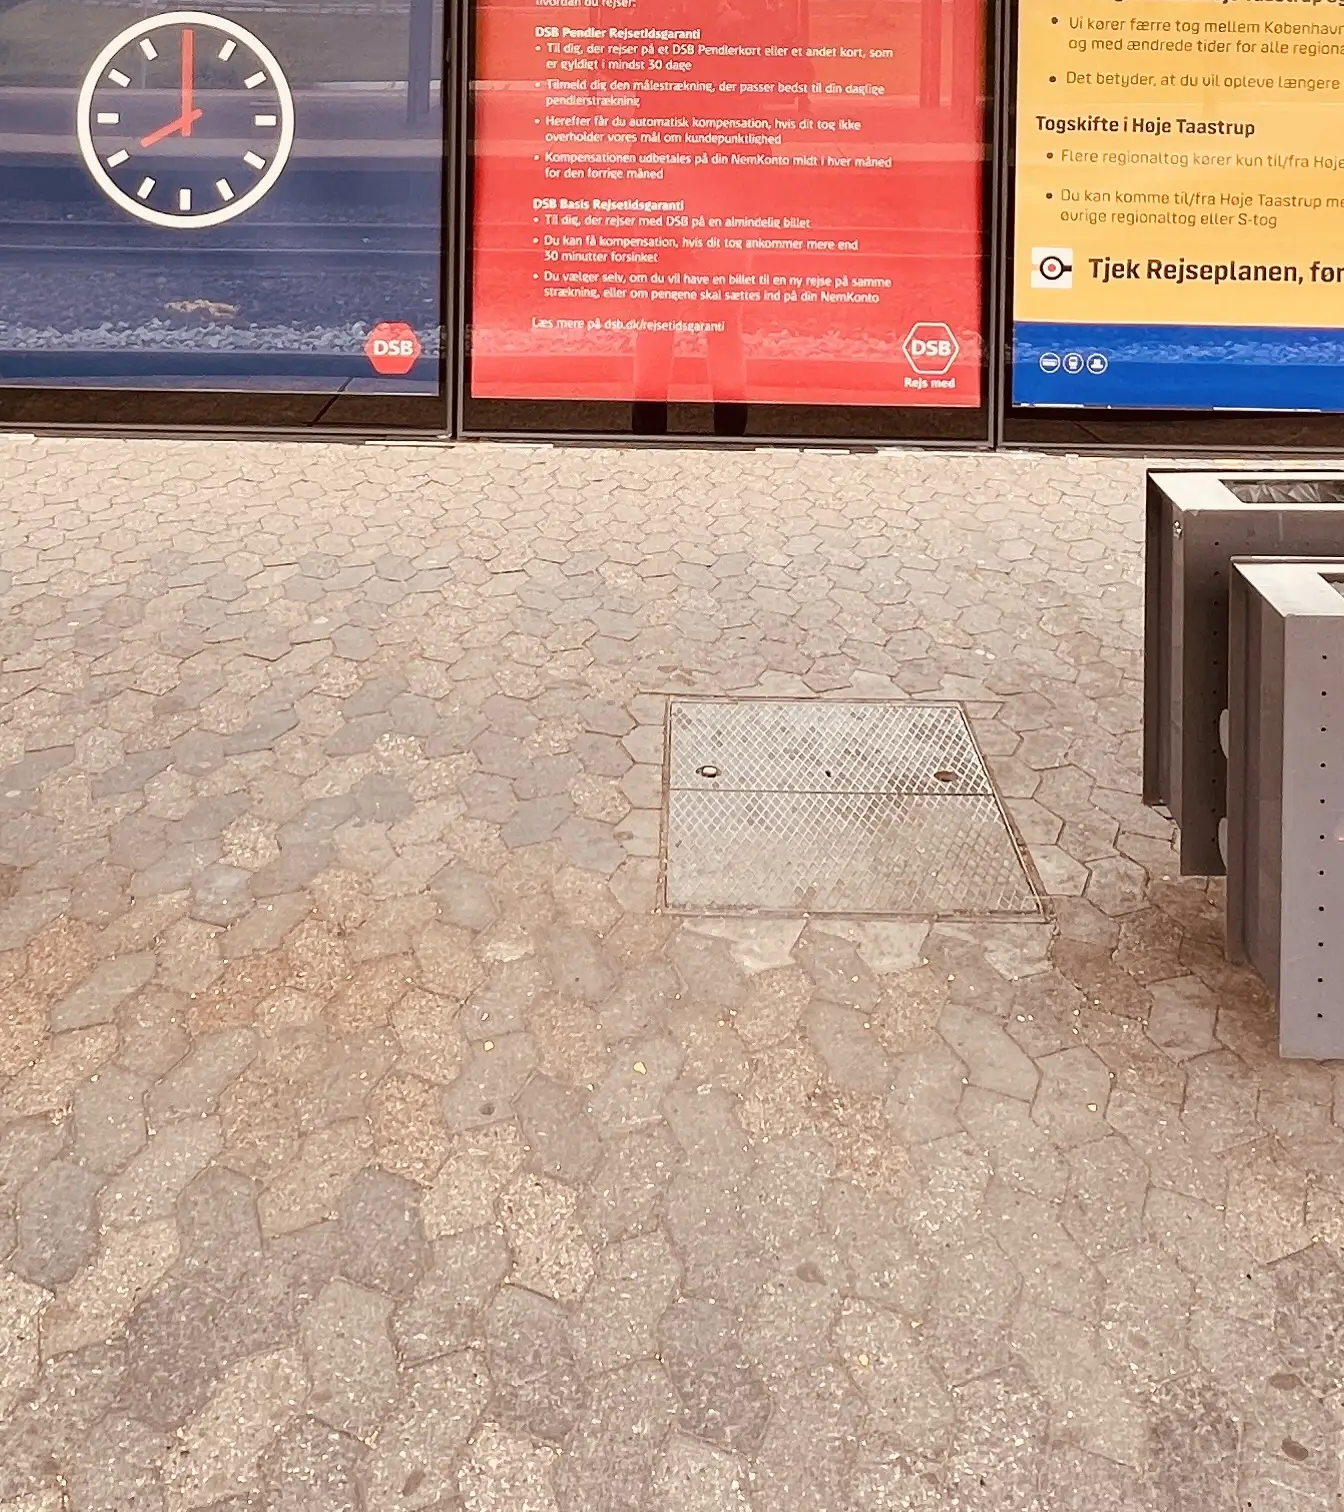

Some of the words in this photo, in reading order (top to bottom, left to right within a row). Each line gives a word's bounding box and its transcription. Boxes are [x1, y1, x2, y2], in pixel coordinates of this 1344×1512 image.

[535, 27, 558, 40] DSB
[562, 26, 606, 37] Pendler
[609, 26, 700, 41] Rejsetidsgaranti
[1069, 15, 1083, 29] Vi
[1087, 17, 1126, 30] kører
[1130, 17, 1171, 31] færre
[1175, 19, 1200, 34] tog
[1204, 19, 1260, 33] mellem
[1068, 39, 1086, 52] og
[1091, 37, 1122, 50] med
[1126, 38, 1192, 51] ændrede
[1196, 39, 1231, 52] tider
[1236, 39, 1256, 52] for
[1260, 40, 1288, 53] alle
[1066, 71, 1092, 84] Det
[1096, 72, 1156, 88] betyder,
[1160, 74, 1176, 86] at
[1179, 74, 1198, 86] du
[1202, 74, 1220, 86] vil
[1223, 76, 1274, 89] opleve
[1278, 76, 1340, 91] længere
[1036, 114, 1118, 134] Togskifte
[1123, 116, 1127, 131] i
[1132, 116, 1171, 136] Høje
[1176, 118, 1254, 138] Taastrup
[1061, 148, 1098, 162] Flere
[1102, 150, 1188, 167] regionaltog
[1193, 152, 1231, 165] kører
[1235, 154, 1263, 166] kun
[1267, 154, 1309, 169] til/fra
[533, 198, 557, 209] DSB
[559, 198, 590, 209] Basis
[592, 198, 684, 213] Rejsetidsgaranti
[1060, 188, 1079, 201] Du
[1084, 189, 1110, 202] kan
[1115, 190, 1169, 204] komme
[1174, 191, 1215, 207] til/fra
[1220, 192, 1253, 208] Høje
[1259, 194, 1322, 209] Taastrup
[1060, 208, 1106, 224] øvrige
[1111, 210, 1196, 227] regionaltog
[1200, 213, 1233, 225] eller
[1237, 212, 1277, 228] S-tog
[1088, 256, 1140, 283] Tjek
[1146, 257, 1303, 286] Rejseplanen,
[373, 339, 414, 356] DSB
[911, 339, 950, 355] DSB
[904, 376, 928, 390] Rejs
[931, 377, 955, 388] med
